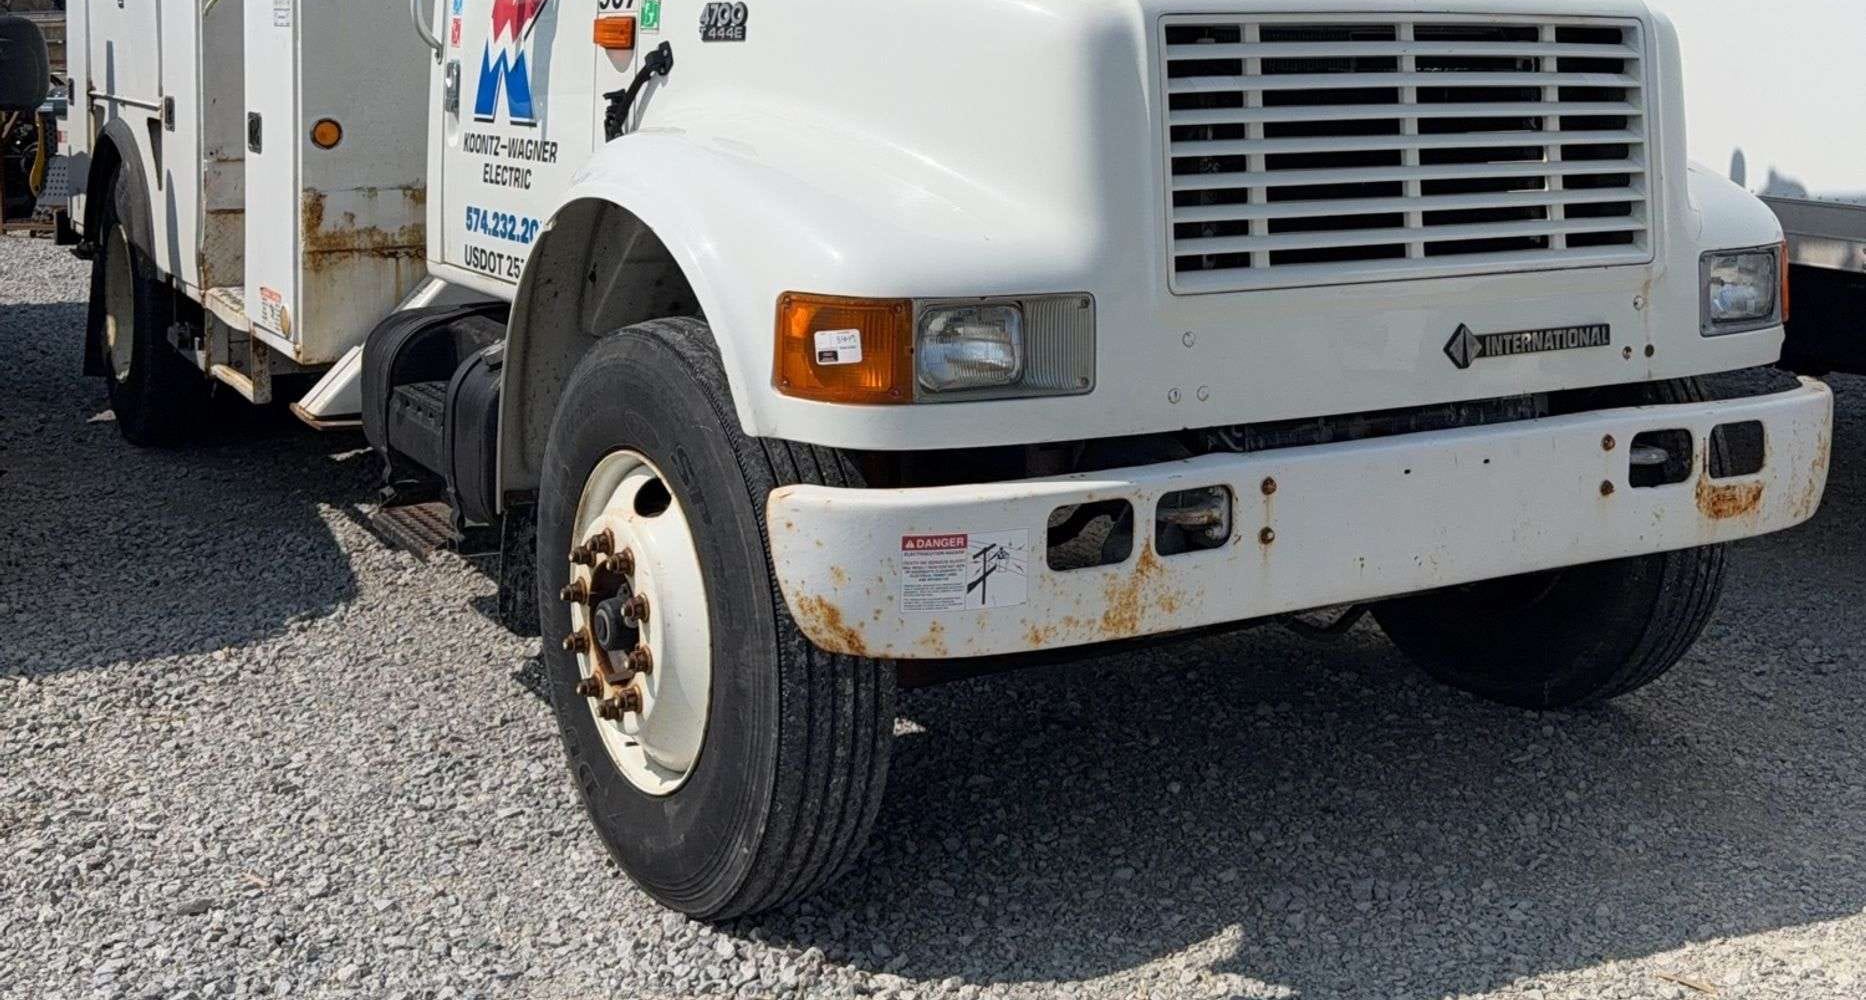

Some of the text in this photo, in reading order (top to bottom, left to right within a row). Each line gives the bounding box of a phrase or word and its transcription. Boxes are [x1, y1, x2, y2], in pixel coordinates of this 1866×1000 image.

[699, 2, 748, 27] 4700
[708, 26, 743, 39] 444E
[463, 132, 558, 163] KOONTZ-WAGNER
[482, 163, 532, 190] ELECTRIC
[465, 206, 542, 244] 574.232.20
[464, 244, 525, 279] USDOT 25
[1485, 325, 1609, 357] INTERNATIONAL
[916, 537, 964, 548] DANGER
